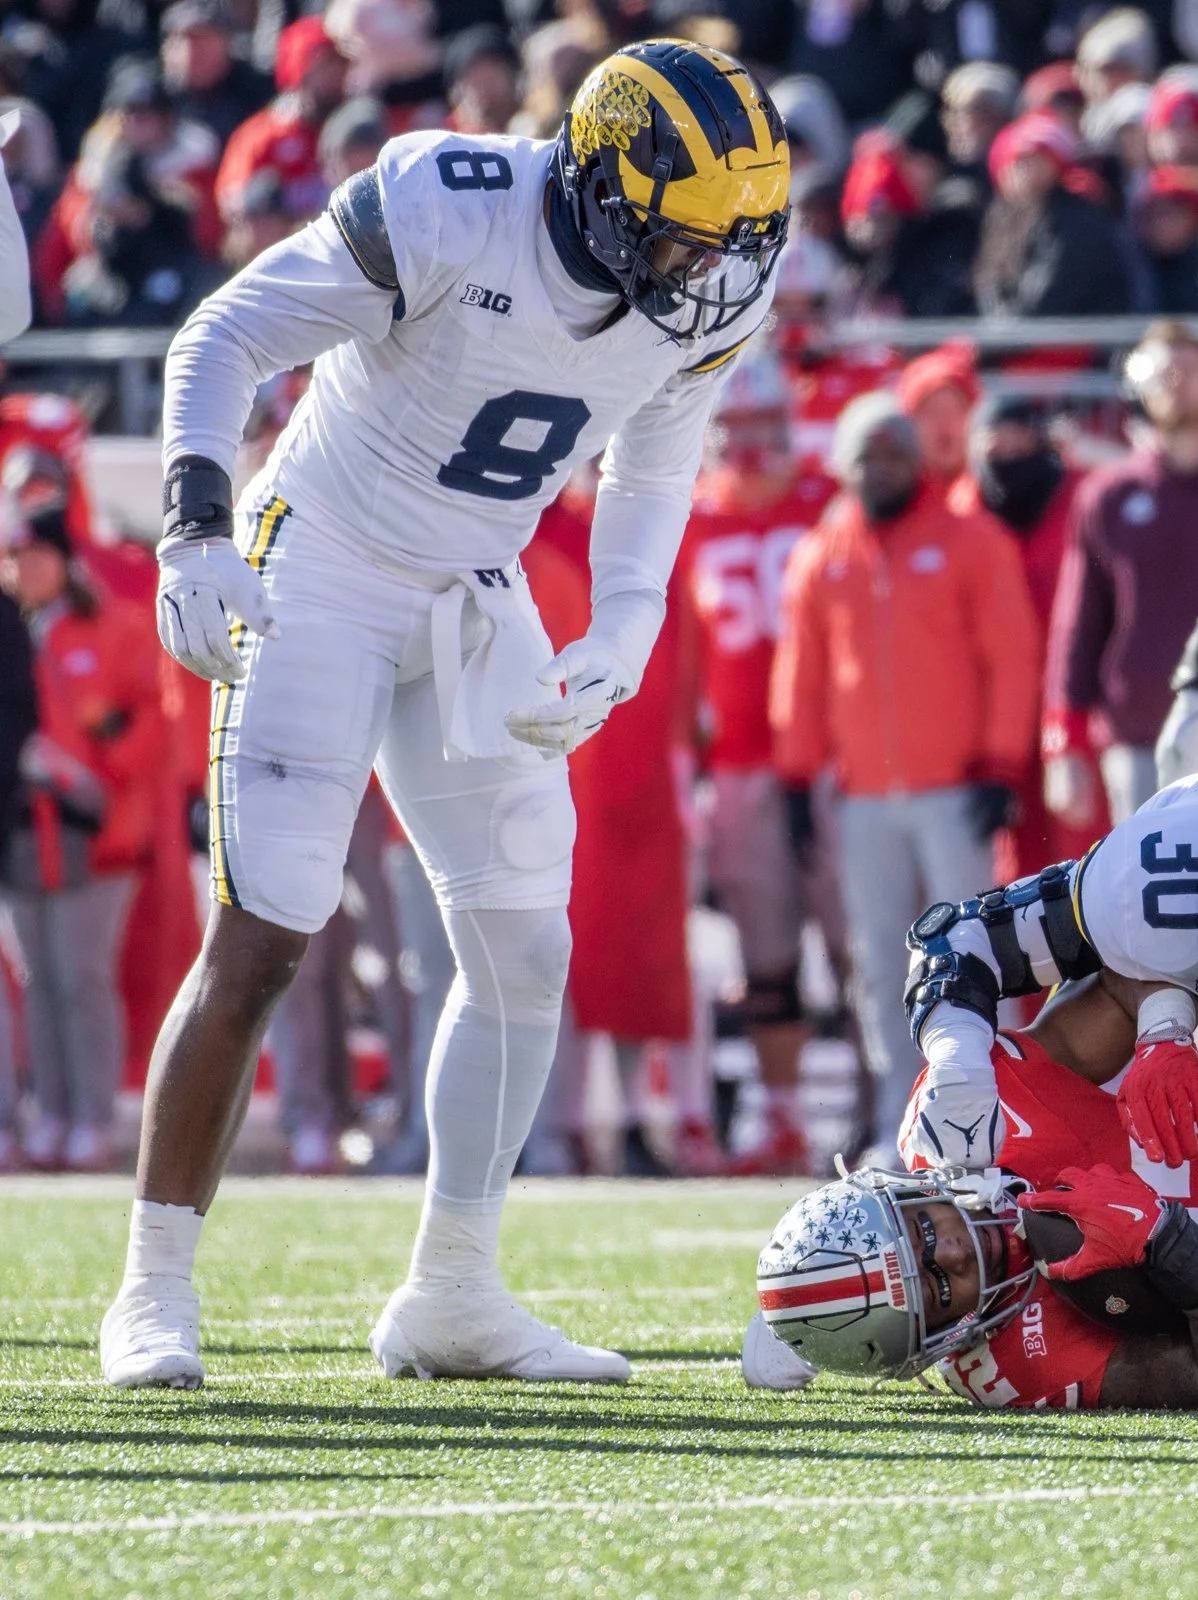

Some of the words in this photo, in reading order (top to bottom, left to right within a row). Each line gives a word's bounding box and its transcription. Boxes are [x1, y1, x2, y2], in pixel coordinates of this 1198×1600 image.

[436, 150, 514, 192] 8
[437, 389, 592, 501] 8
[884, 1250, 901, 1281] STATE
[890, 1282, 906, 1308] OHIO
